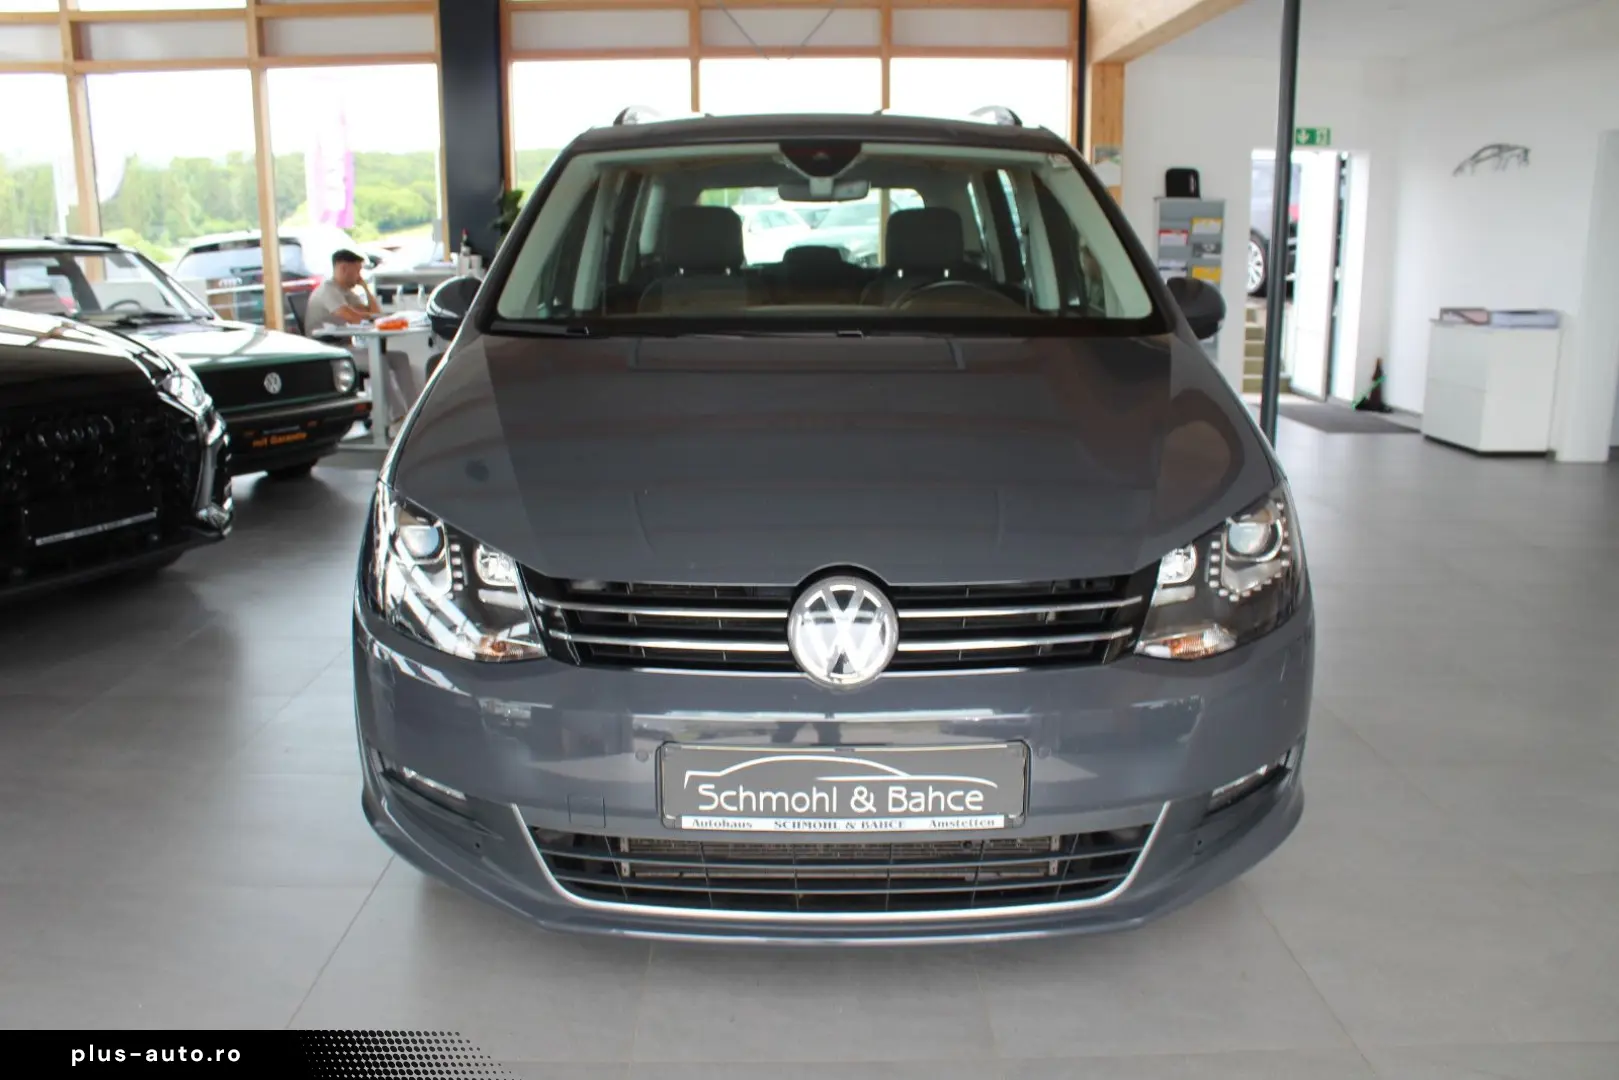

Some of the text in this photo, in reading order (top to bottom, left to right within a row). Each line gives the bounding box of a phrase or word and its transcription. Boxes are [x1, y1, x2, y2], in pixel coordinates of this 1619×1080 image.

[697, 784, 985, 813] Schmohl & Bahce
[692, 817, 995, 830] Autohaus SCHMOHL & BAHCE Amstetten
